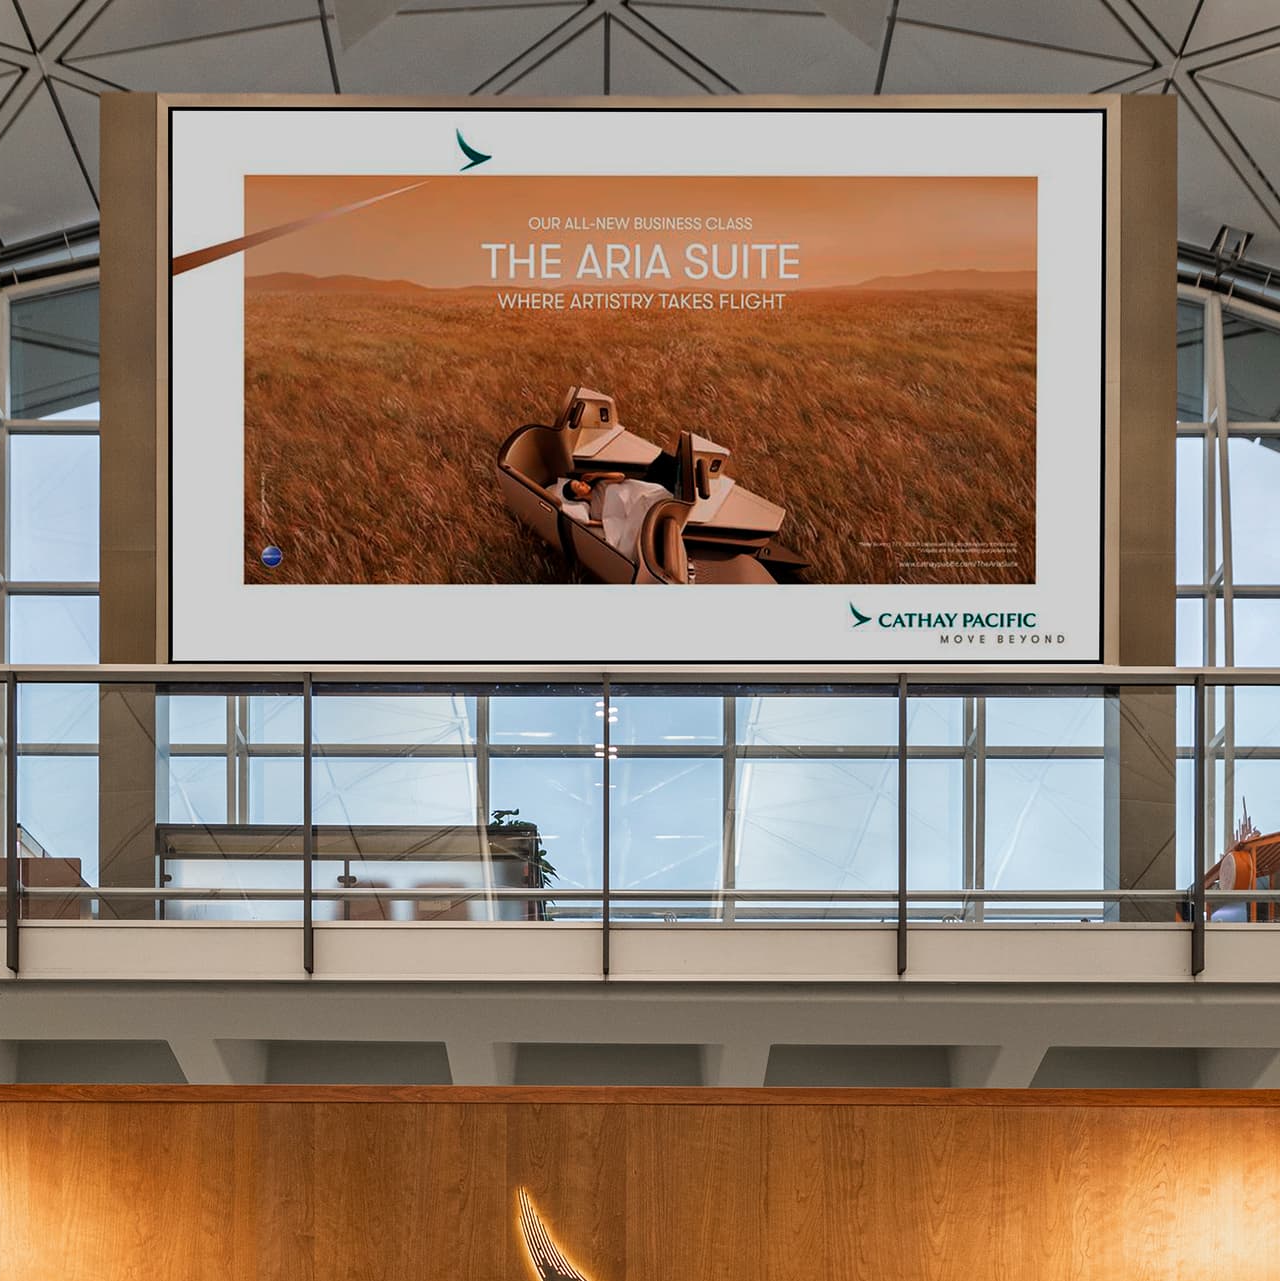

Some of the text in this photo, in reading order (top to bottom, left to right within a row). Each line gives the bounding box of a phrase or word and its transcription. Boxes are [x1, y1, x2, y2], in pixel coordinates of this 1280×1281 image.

[528, 216, 753, 231] OUR ALL-NEW BUSINESS CLASS
[481, 243, 801, 280] THE ARIA SUITE
[497, 293, 786, 310] WHERE ARTISTRY TAKES FLIGHT
[878, 612, 1037, 628] CATHAY PACIFIC
[939, 634, 1066, 644] MOVE BEYOND
